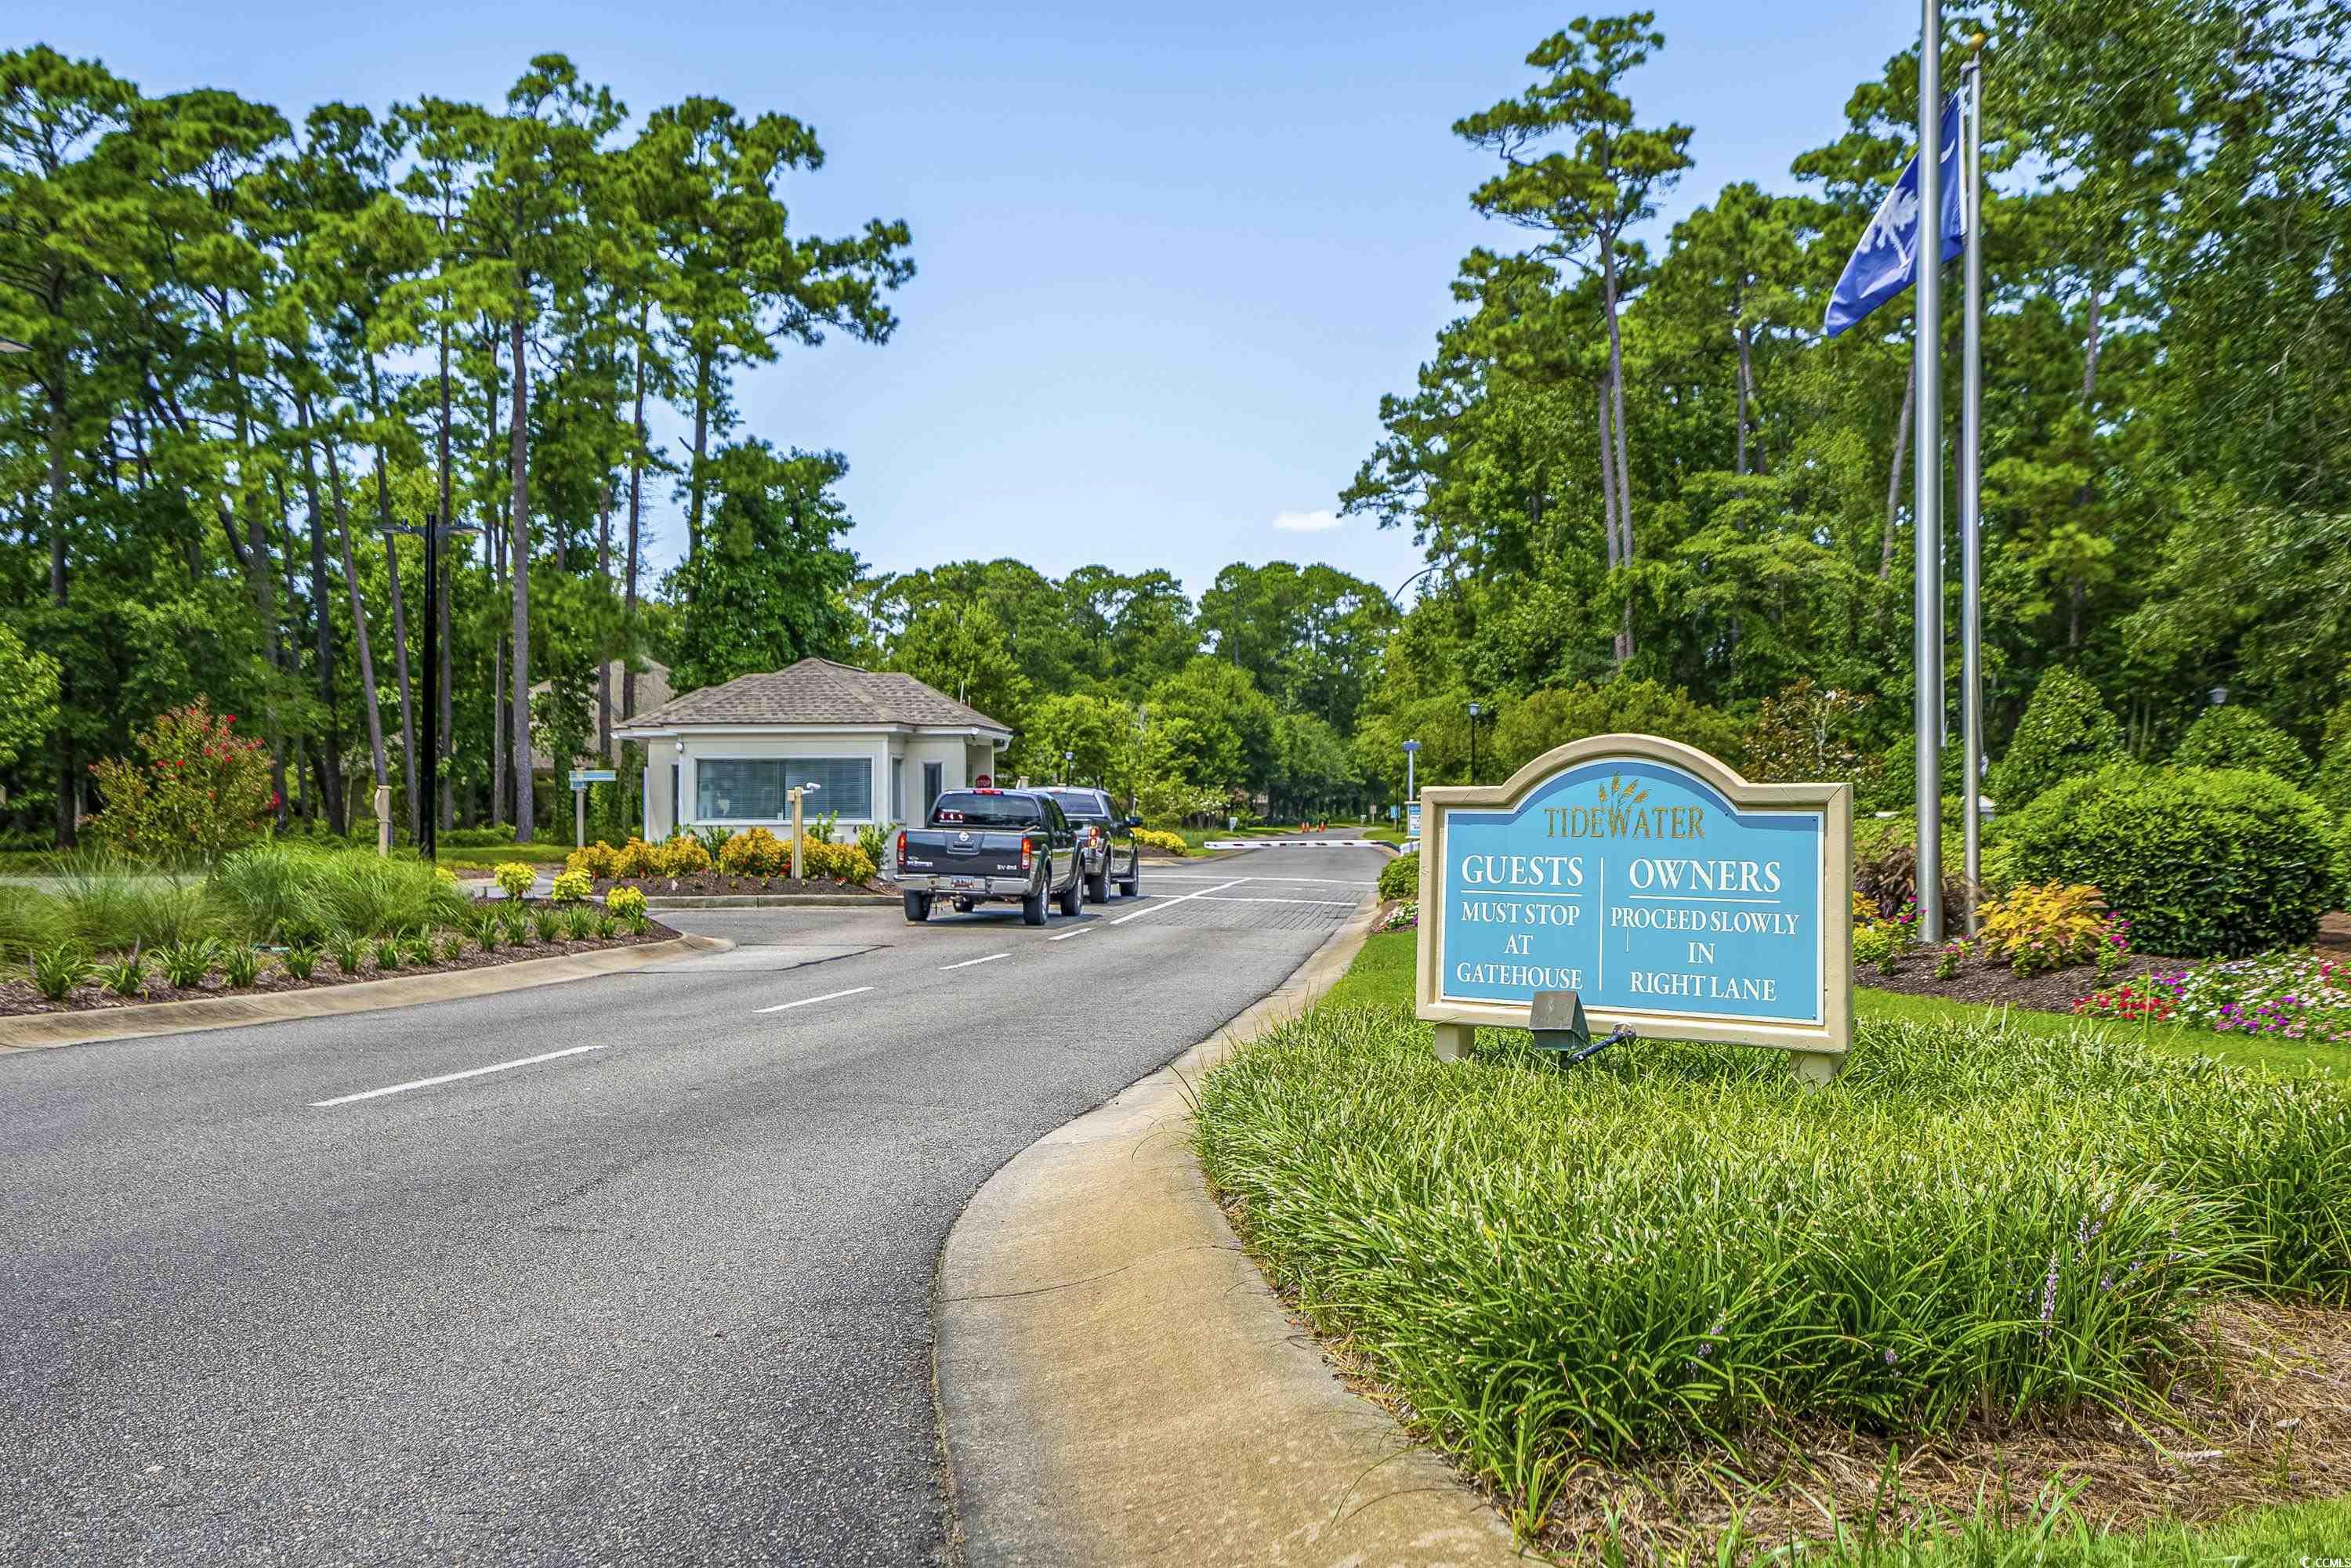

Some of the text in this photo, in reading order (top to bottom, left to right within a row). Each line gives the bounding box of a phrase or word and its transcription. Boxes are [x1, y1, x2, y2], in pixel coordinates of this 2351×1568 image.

[1542, 806, 1706, 839] TIDEWATER
[1462, 854, 1584, 886] GUESTS
[1629, 858, 1781, 893] OWNERS
[1461, 901, 1580, 925] MUST STOP
[1610, 907, 1799, 934] PROCEED SLOWLY
[1504, 933, 1534, 954] AT
[1687, 941, 1715, 965] IN
[1456, 962, 1583, 990] GATEHOUSE
[1630, 971, 1776, 1002] RIGHT LANE
